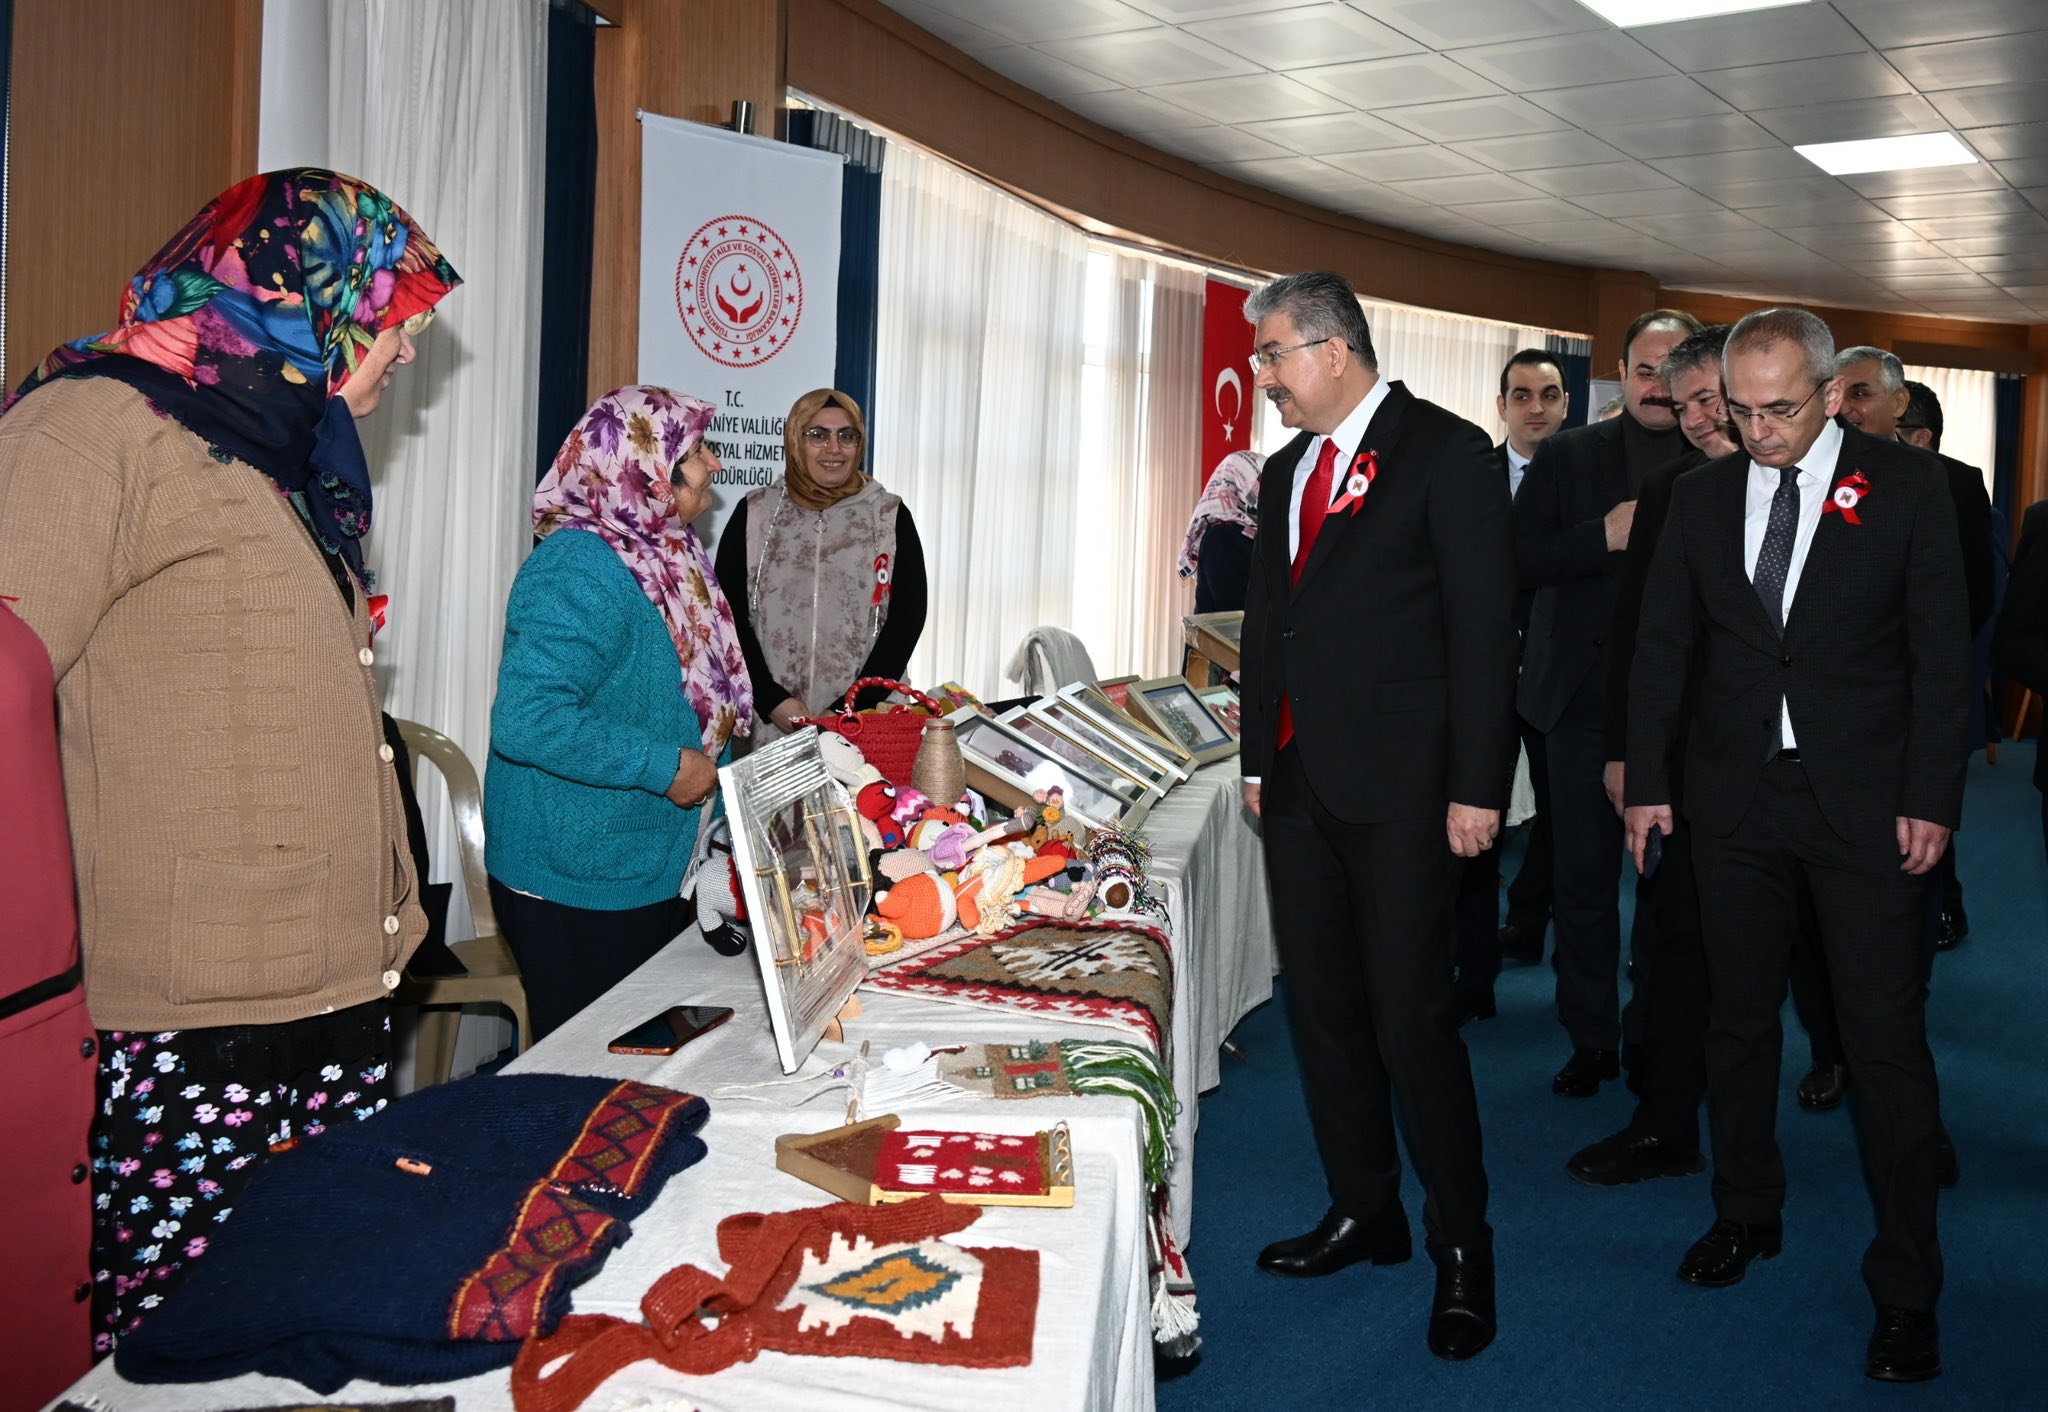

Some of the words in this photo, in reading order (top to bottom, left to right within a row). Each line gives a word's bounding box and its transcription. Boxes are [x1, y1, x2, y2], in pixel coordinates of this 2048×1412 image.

[717, 243, 732, 256] AİLE
[732, 243, 743, 251] VE
[744, 244, 767, 265] SOSYAL
[699, 252, 718, 309] CUMHURİYETİ
[766, 263, 780, 309] HİZMETLER
[703, 311, 729, 338] TÜRKİYE
[746, 309, 777, 340] BAKANLIĞI
[725, 390, 744, 408] T.C.
[704, 413, 739, 433] ANİYE
[741, 415, 786, 436] VALİLİĞİ
[705, 441, 741, 459] OSYAL
[744, 440, 785, 462] HİZMET
